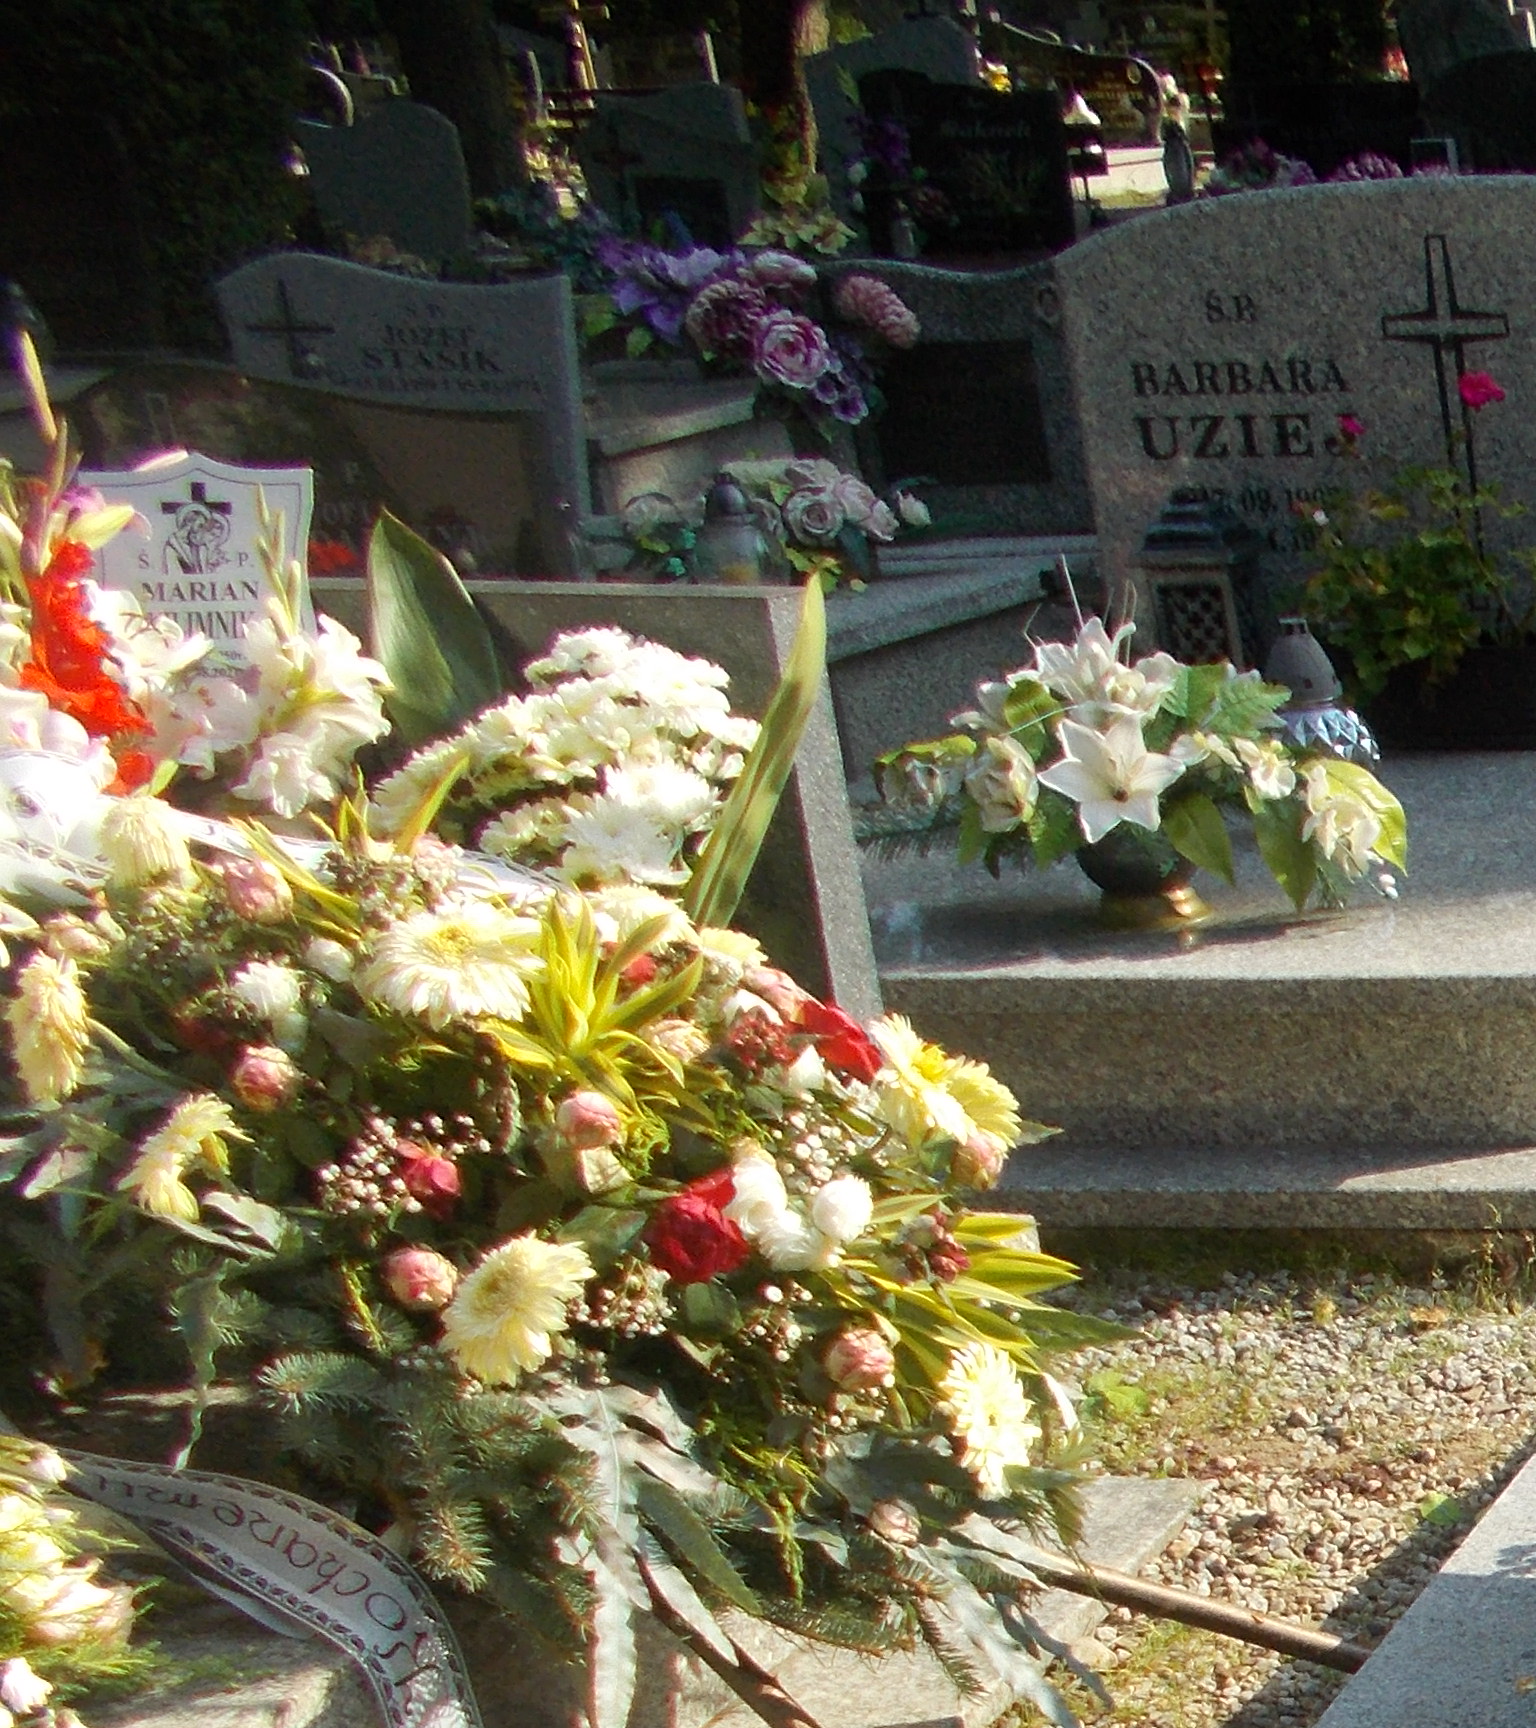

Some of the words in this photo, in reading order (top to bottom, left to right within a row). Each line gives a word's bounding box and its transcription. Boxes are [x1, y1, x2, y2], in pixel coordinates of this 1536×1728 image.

[1130, 356, 1354, 397] BARBARA
[1132, 411, 1362, 461] UZIEJ
[141, 580, 260, 602] MARIAN
